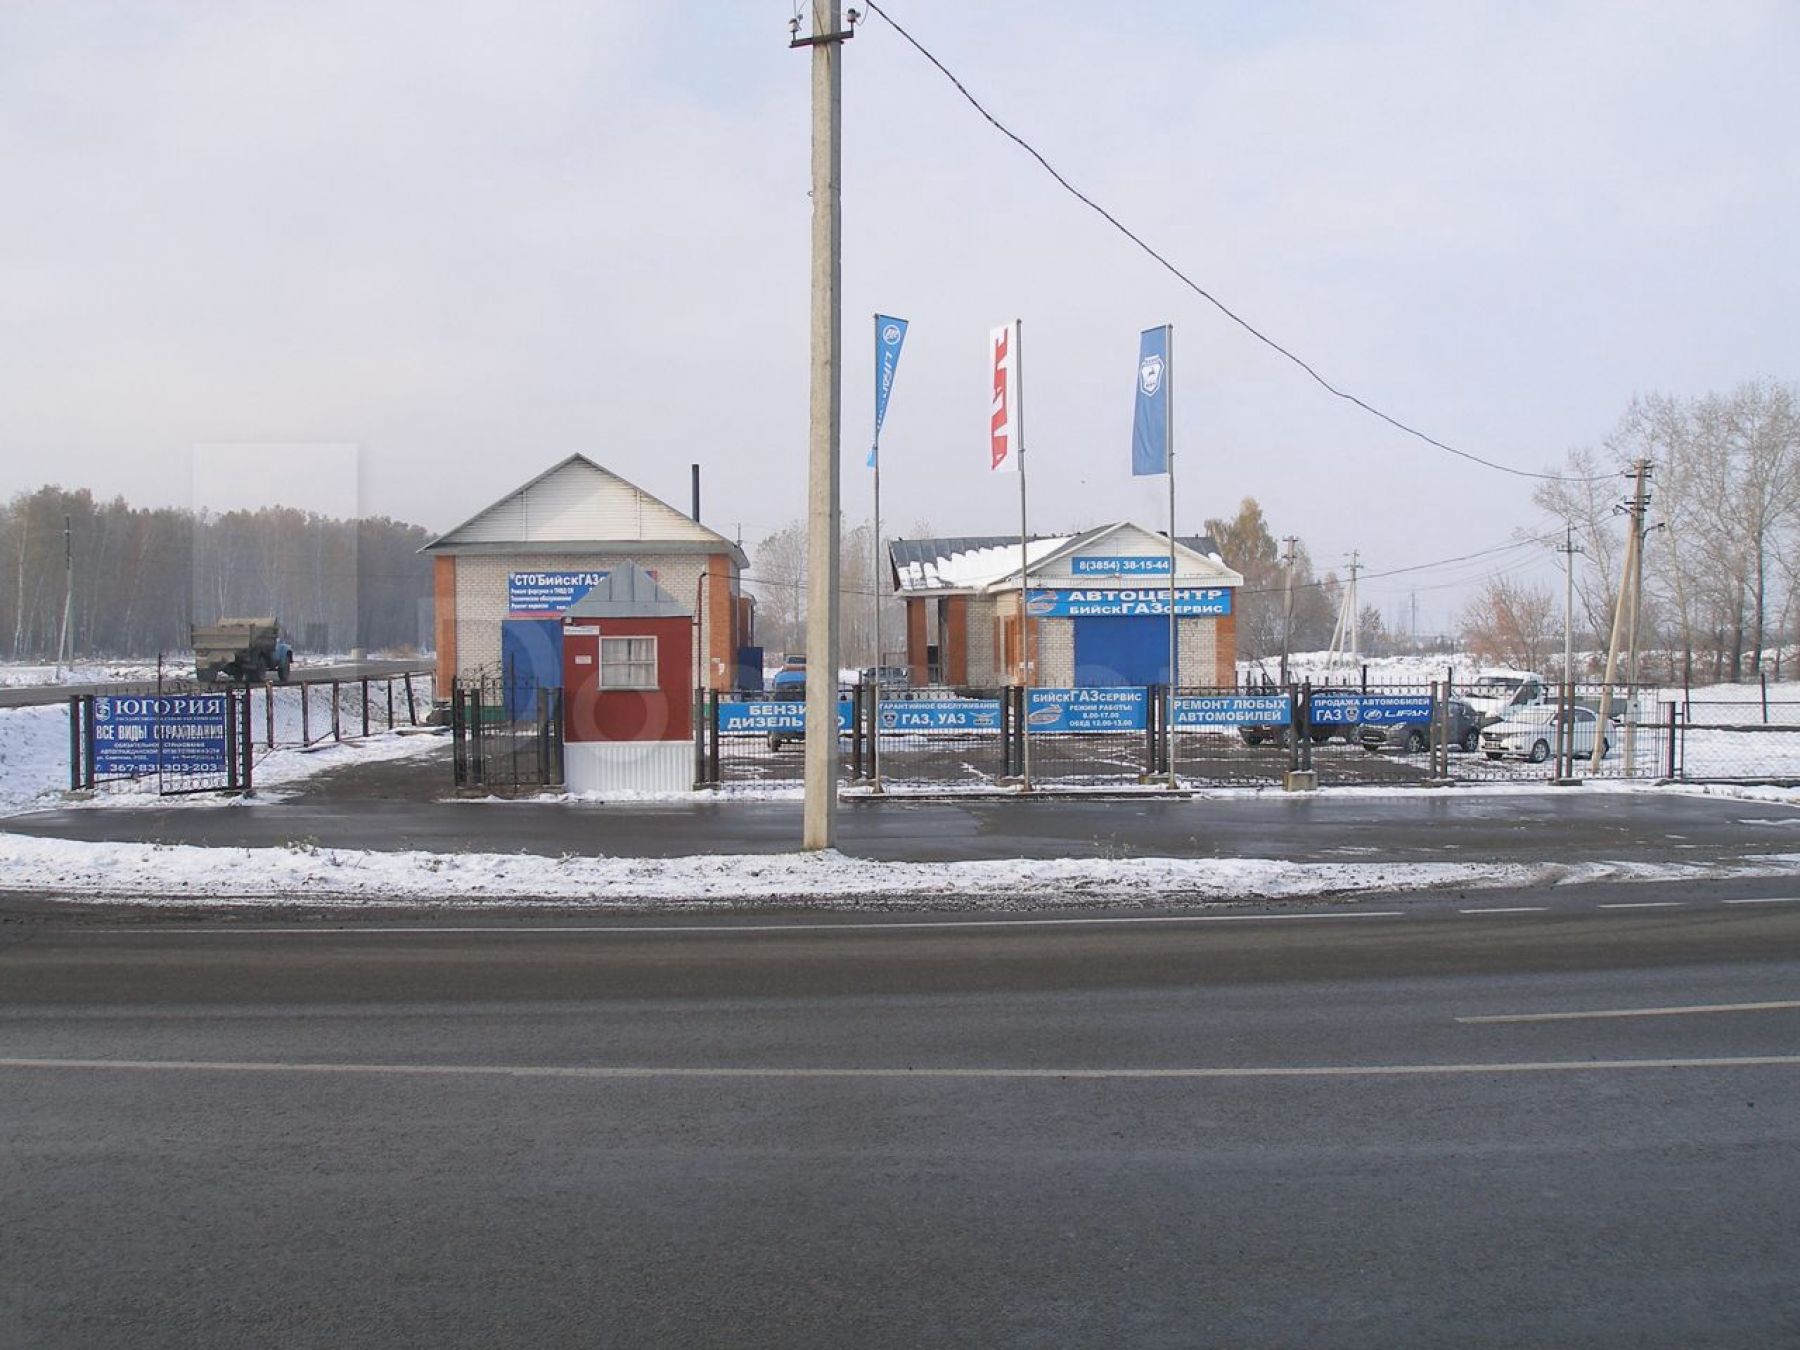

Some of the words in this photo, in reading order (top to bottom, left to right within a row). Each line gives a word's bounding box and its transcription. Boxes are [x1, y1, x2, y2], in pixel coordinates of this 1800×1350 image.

[1080, 561, 1119, 571] 8(3854)
[1123, 561, 1168, 569] 38-15-44
[1069, 591, 1222, 602] АВТОЦЕНТР
[115, 699, 220, 714] ЮГОРИЯ
[1174, 700, 1229, 710] РЕМОНТ
[1233, 700, 1286, 709] ЛЮБЫХ
[1314, 699, 1360, 707] ПРОДАЖА
[1362, 698, 1430, 706] АВТОМОБИЛЕЙ
[1178, 710, 1281, 721] АВТОМОБИЛЕЙ
[1316, 709, 1342, 721] ГАЗ
[1384, 709, 1429, 718] LIFAN
[902, 714, 934, 726] ГАЗ,
[938, 713, 966, 724] УАЗ
[96, 725, 114, 740] ВСЕ
[118, 725, 147, 741] ВИДЫ
[154, 725, 223, 739] СТРАХОВАНИЯ
[164, 763, 218, 771] 303-203
